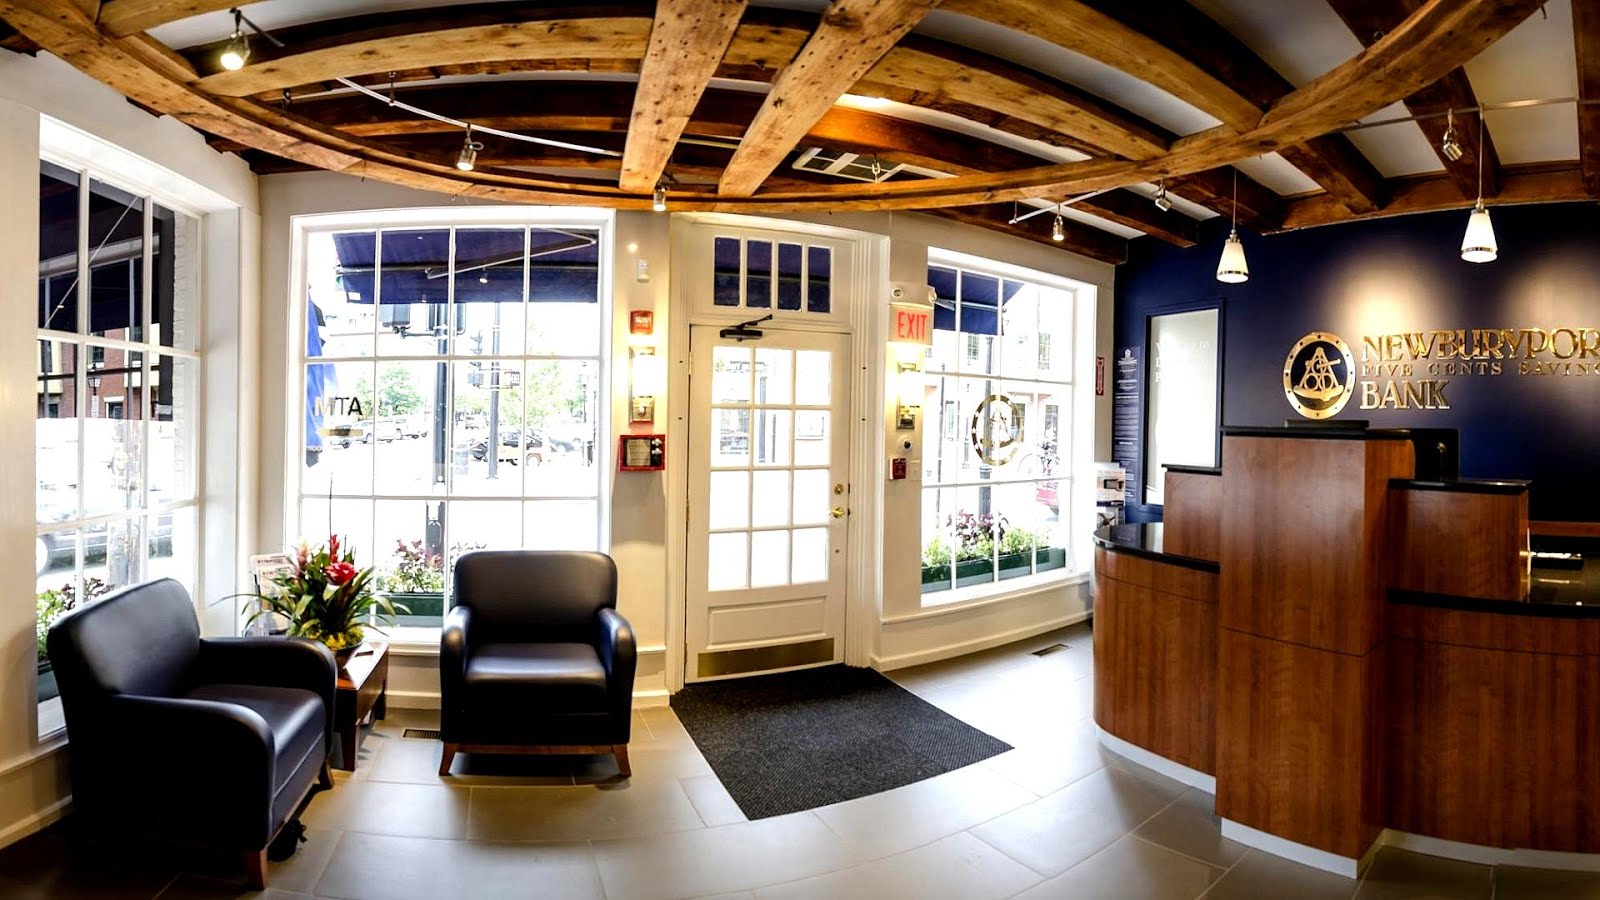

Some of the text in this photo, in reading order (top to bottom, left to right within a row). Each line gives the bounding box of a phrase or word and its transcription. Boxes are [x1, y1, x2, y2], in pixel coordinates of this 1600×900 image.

[898, 311, 928, 340] EXIT
[1361, 362, 1413, 377] FIVE
[1428, 362, 1502, 376] CENTS
[1360, 380, 1450, 410] BANK
